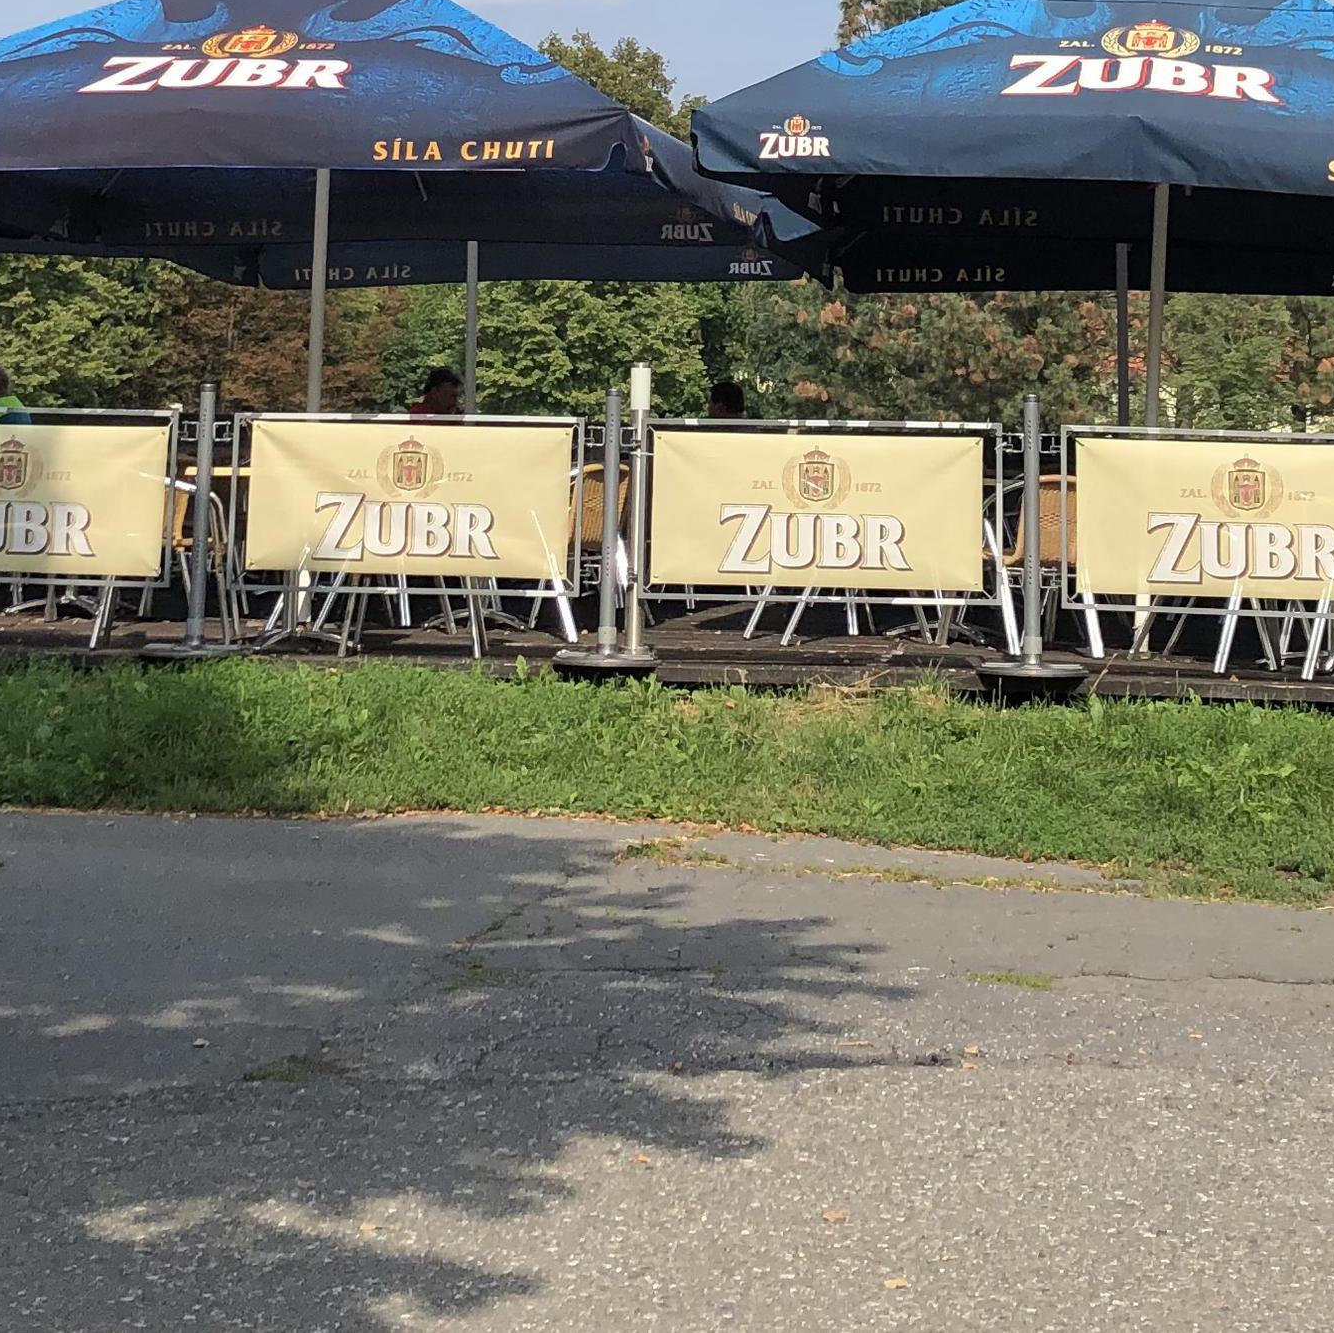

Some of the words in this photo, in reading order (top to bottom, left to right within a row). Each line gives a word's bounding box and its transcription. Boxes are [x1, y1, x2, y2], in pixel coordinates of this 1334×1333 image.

[1058, 40, 1095, 48] ZAL.
[1205, 45, 1243, 56] 1872
[76, 55, 352, 93] ZUBR
[999, 53, 1286, 106] ZUBR
[373, 137, 443, 161] SÍLA
[460, 139, 556, 160] CHUTI
[758, 133, 831, 159] ZUBR
[752, 480, 778, 490] ZAL.
[855, 482, 882, 493] 1872
[1180, 488, 1207, 498] ZAL.
[312, 491, 501, 561] ZUBR
[718, 503, 914, 574] ZUBR
